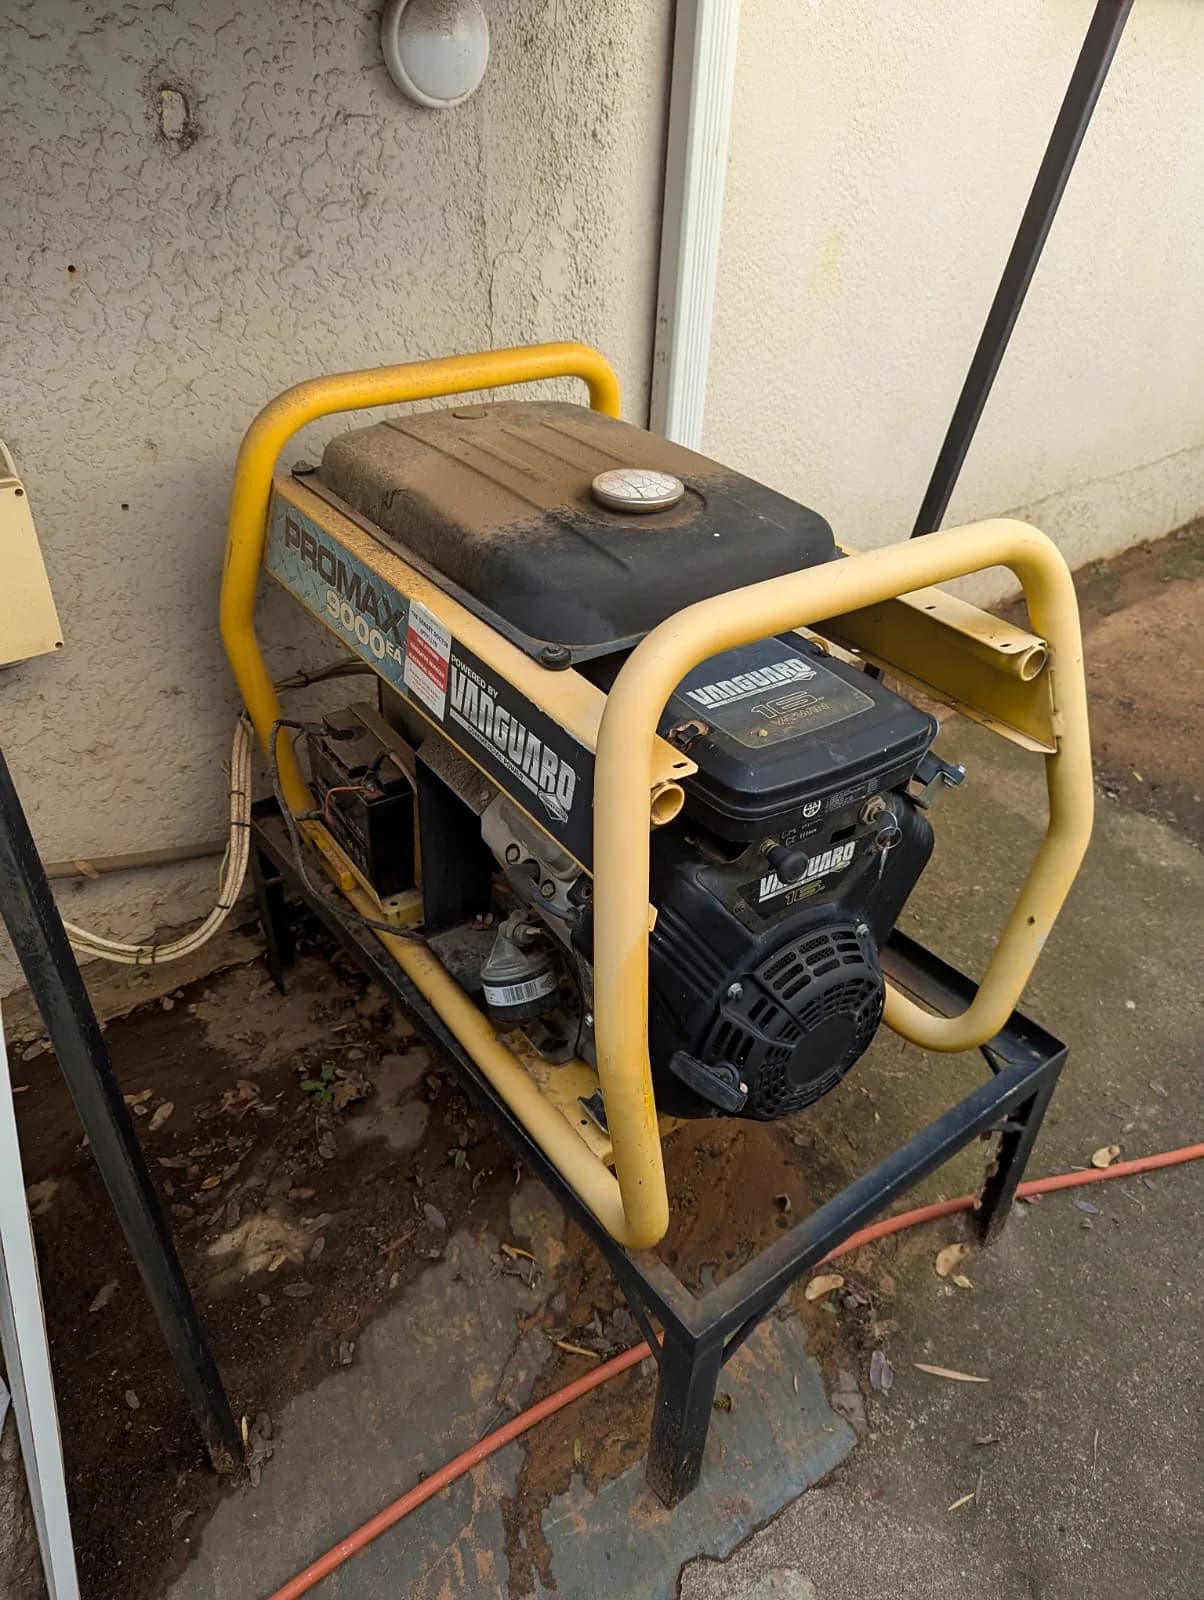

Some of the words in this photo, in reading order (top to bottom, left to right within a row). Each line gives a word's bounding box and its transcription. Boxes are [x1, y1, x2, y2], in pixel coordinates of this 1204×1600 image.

[285, 514, 406, 645] PROMAX
[451, 654, 486, 690] POWERED
[487, 685, 499, 699] BY
[685, 658, 812, 706] VANGUARD
[450, 665, 577, 811] VANGUARD
[759, 841, 857, 898] VAUARD
